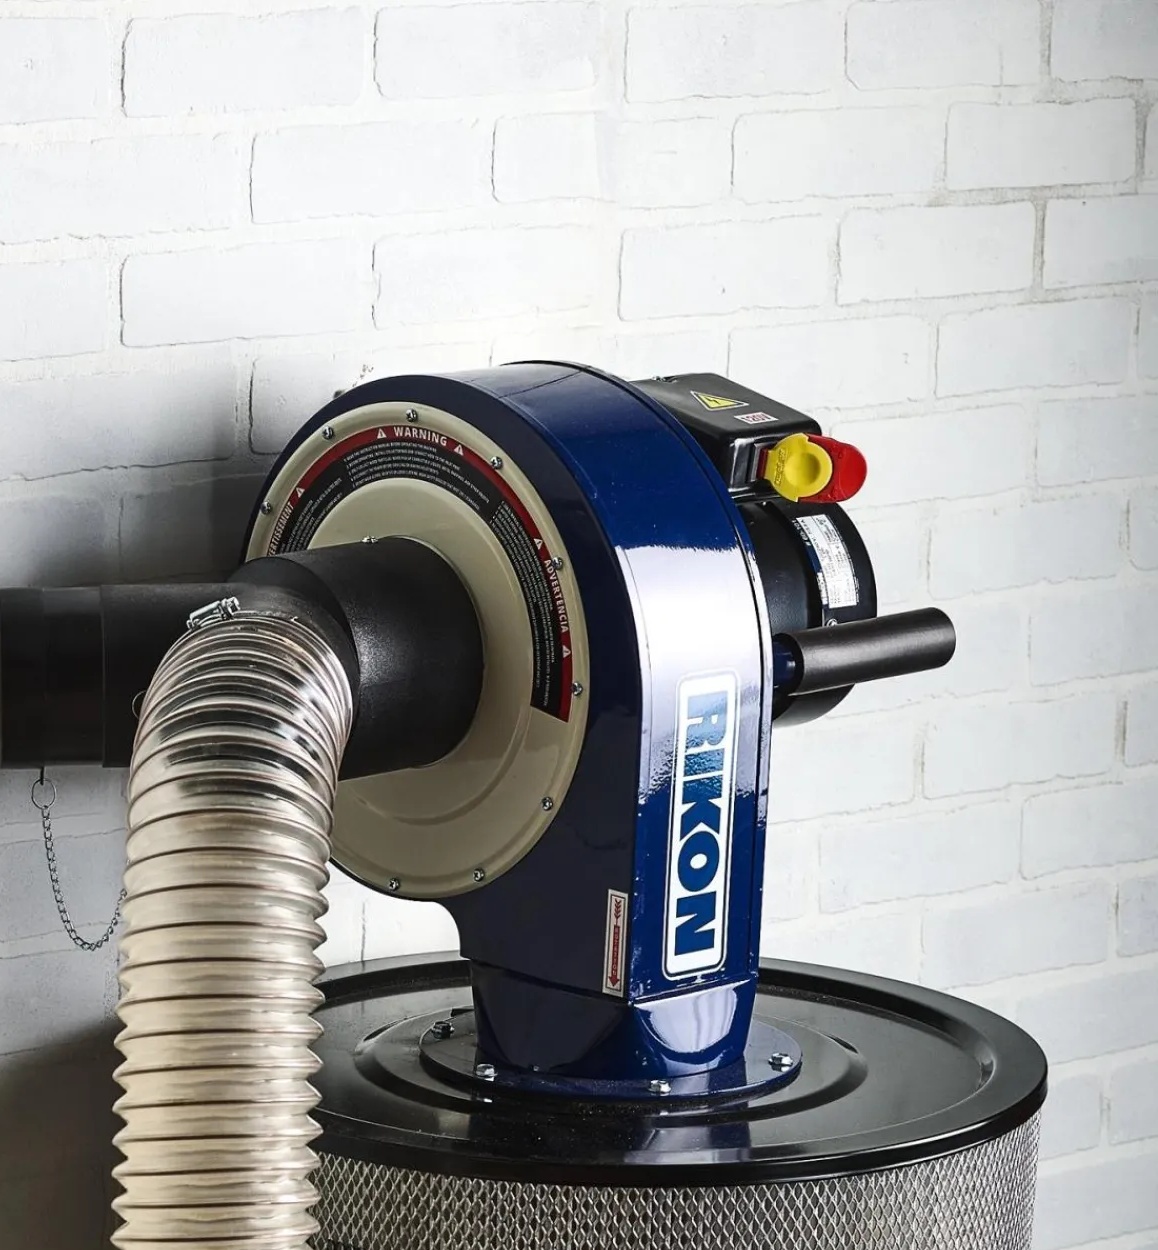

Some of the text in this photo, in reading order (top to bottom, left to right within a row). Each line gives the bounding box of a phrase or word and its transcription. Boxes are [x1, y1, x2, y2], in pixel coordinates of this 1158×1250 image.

[393, 427, 447, 446] WARNING
[268, 501, 294, 556] ERTISSEMENT
[544, 560, 569, 633] ADVERTENCIA
[674, 690, 728, 956] RIKON
